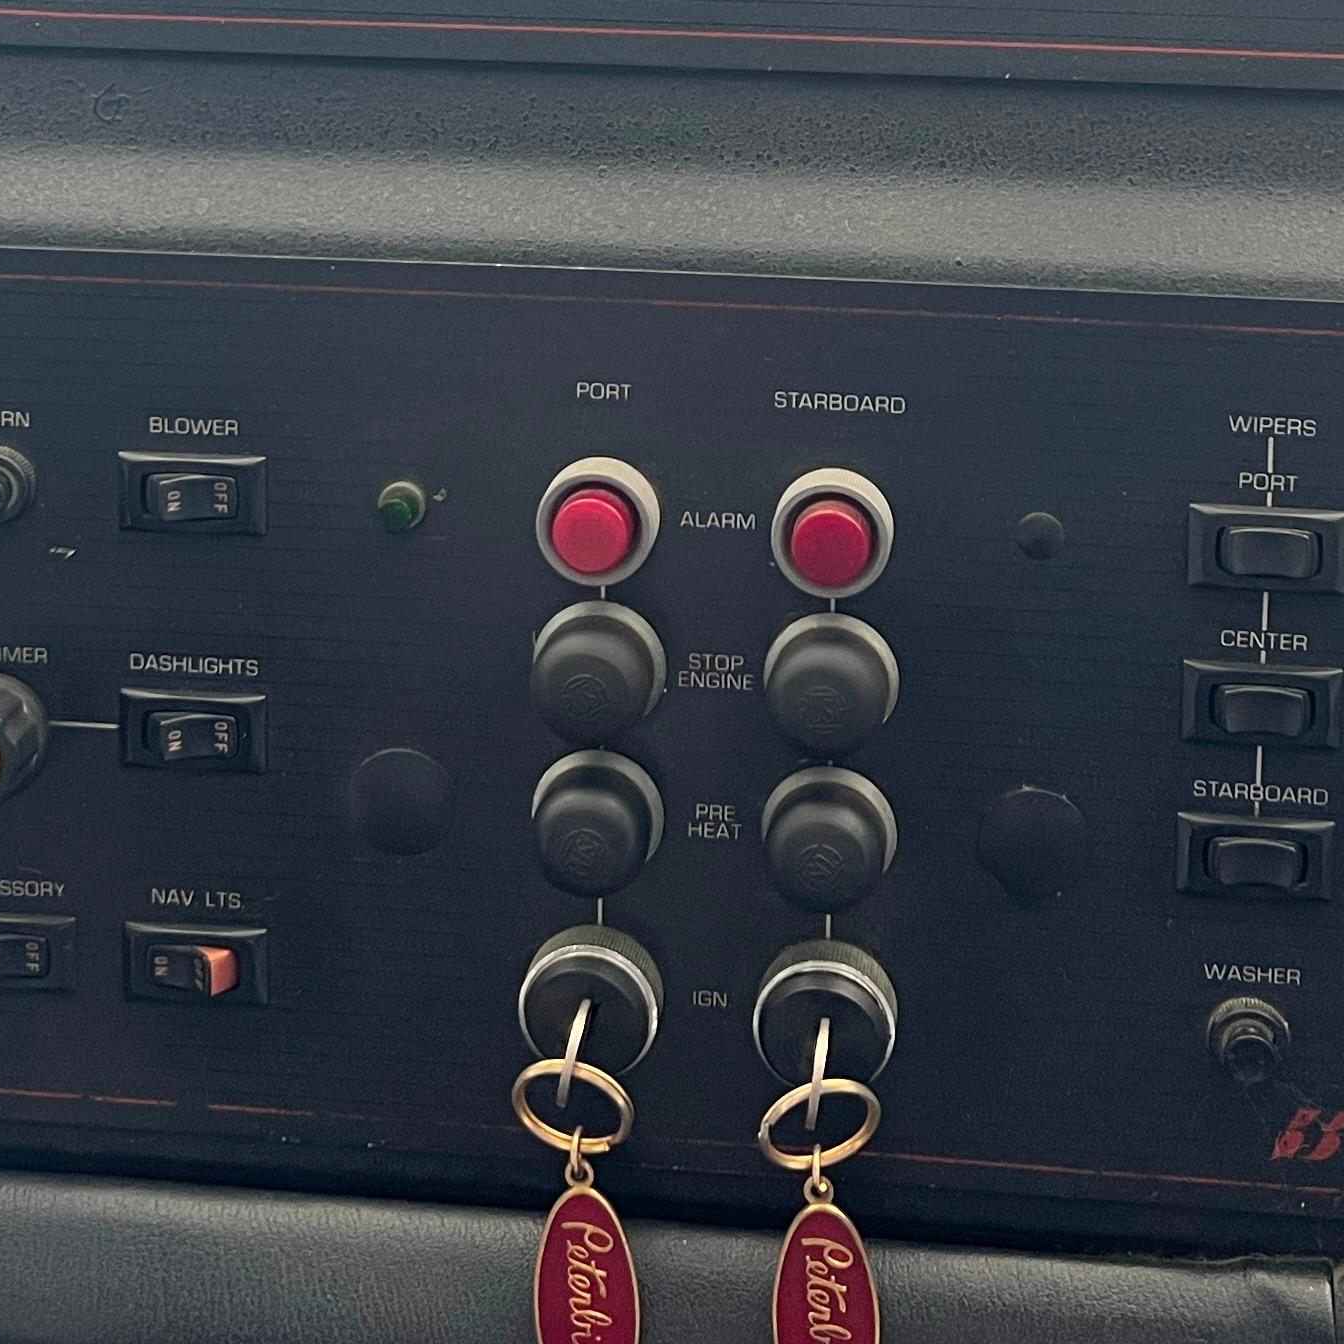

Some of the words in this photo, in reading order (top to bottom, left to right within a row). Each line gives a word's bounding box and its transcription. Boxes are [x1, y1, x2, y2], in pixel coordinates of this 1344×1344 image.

[575, 382, 632, 401] PORT
[773, 391, 907, 415] STARBOARD
[149, 416, 239, 437] BLOWER
[1228, 414, 1317, 439] WIPERS
[1238, 471, 1298, 493] PORT
[167, 490, 182, 513] ON
[214, 482, 228, 514] OFF
[679, 510, 756, 531] ALARM
[1219, 628, 1309, 652] CENTER
[129, 652, 260, 677] DASHLIGHTS
[688, 652, 745, 672] STOP
[678, 670, 755, 691] ENGINE
[167, 729, 183, 753] ON
[214, 720, 229, 754] OFF
[1192, 778, 1329, 807] STARBOARD
[695, 803, 736, 822] PRE
[687, 820, 743, 840] HEAT
[150, 887, 196, 907] NAV
[24, 941, 41, 973] OFF
[154, 955, 169, 977] ON
[1202, 962, 1302, 986] WASHER
[691, 990, 728, 1007] IGN
